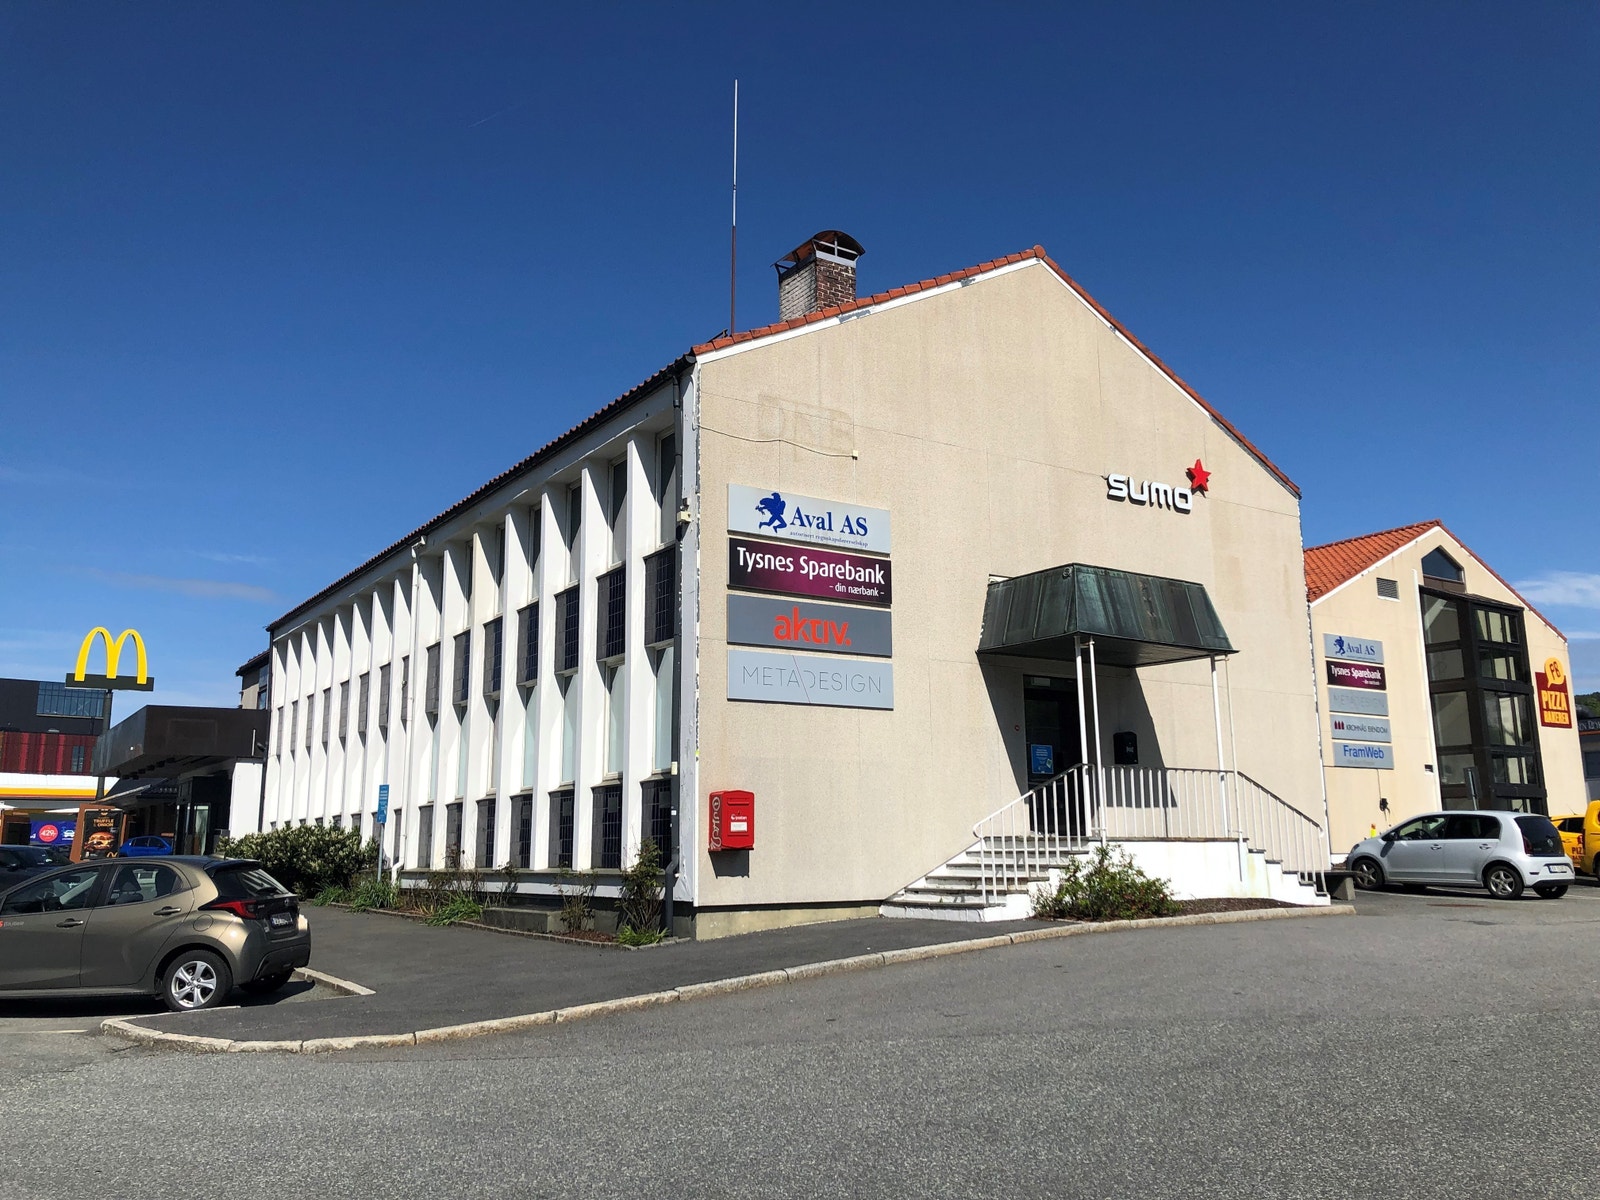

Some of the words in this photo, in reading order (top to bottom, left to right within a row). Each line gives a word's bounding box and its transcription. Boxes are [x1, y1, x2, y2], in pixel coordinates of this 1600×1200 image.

[790, 506, 833, 532] Aval
[841, 514, 868, 537] AS
[736, 546, 794, 573] Tysnes
[799, 555, 885, 585] Sparebank
[835, 583, 847, 593] din
[848, 585, 879, 597] nærbank
[1347, 642, 1362, 654] Aval
[1364, 645, 1376, 656] AS
[1331, 664, 1350, 677] Tysnes
[1351, 667, 1381, 680] Sparebank
[1541, 690, 1568, 711] PIZZA
[1343, 744, 1385, 759] FramWeb
